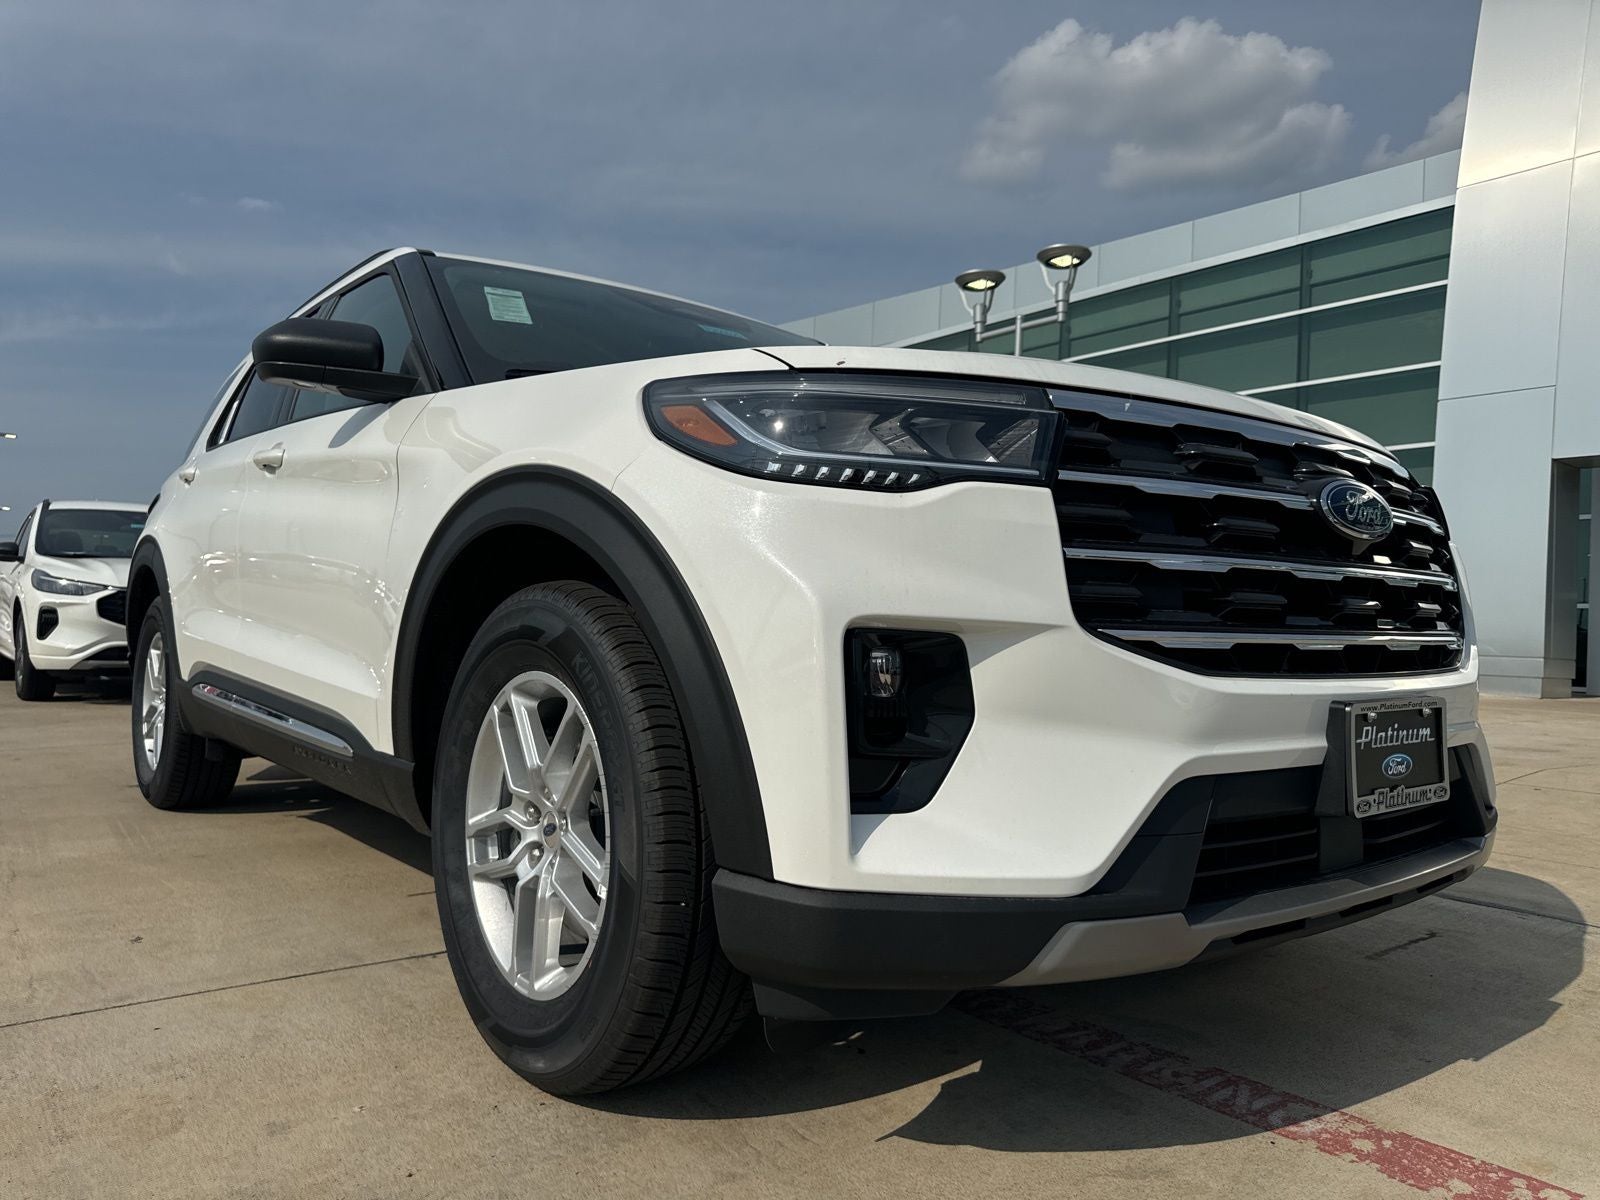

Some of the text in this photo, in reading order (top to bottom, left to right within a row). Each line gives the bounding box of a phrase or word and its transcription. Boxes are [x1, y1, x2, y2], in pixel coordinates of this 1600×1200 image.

[1345, 491, 1387, 524] Ford
[1360, 701, 1438, 711] www.PlatinumFord.com
[1356, 723, 1435, 749] Platinum
[1387, 757, 1407, 775] Ford
[1376, 785, 1432, 811] Platinum
